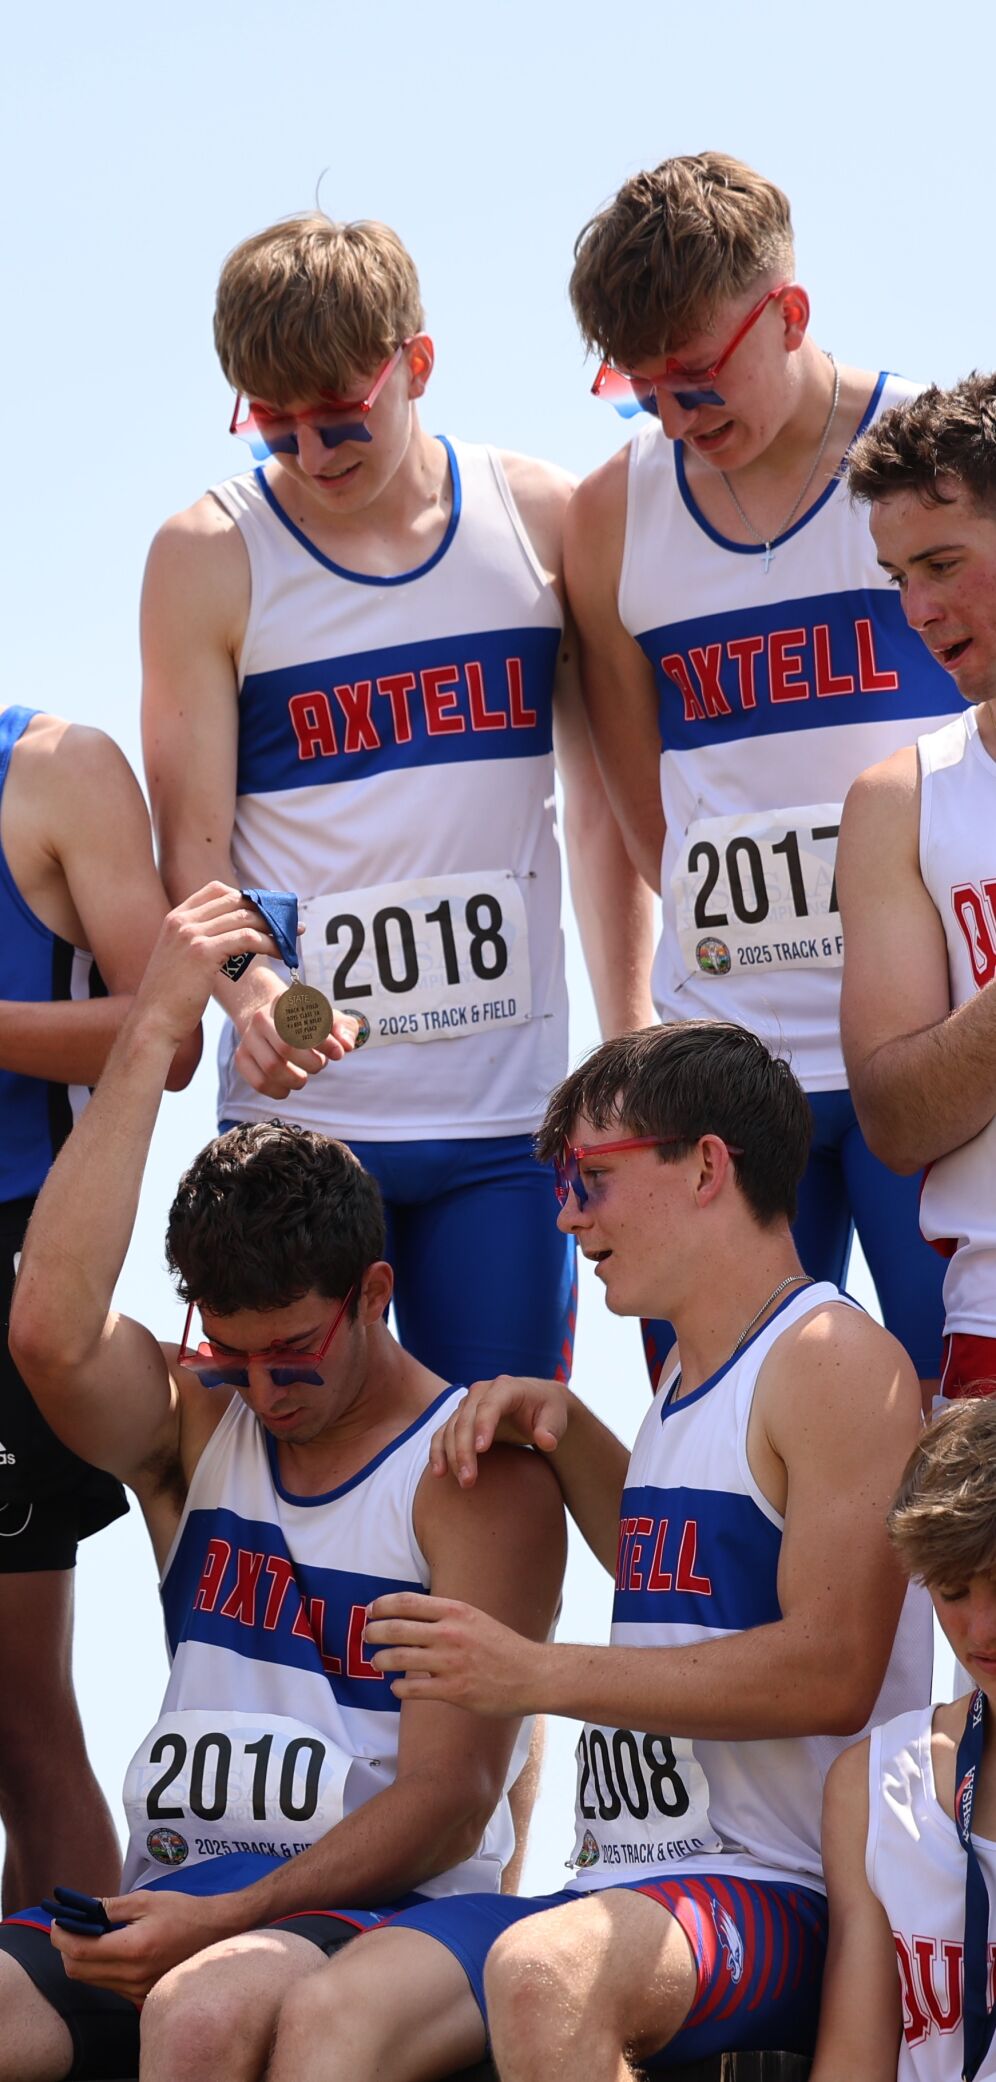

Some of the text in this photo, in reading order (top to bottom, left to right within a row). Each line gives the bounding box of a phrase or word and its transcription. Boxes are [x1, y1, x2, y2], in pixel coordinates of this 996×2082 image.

[661, 618, 899, 721] AXTELL
[288, 657, 537, 760] AXTELL
[325, 893, 508, 1001] 2018
[737, 945, 772, 965] 2025
[773, 939, 819, 961] TRACK
[821, 938, 832, 956] &
[287, 994, 311, 1005] STATE
[379, 998, 516, 1036] 2025 TRACK & FIELD
[0, 1453, 16, 1465] as
[146, 1732, 326, 1822] 2010
[578, 1729, 690, 1821] 2008
[195, 1838, 232, 1856] 2025
[620, 1843, 655, 1864] TRACK
[657, 1843, 667, 1862] &
